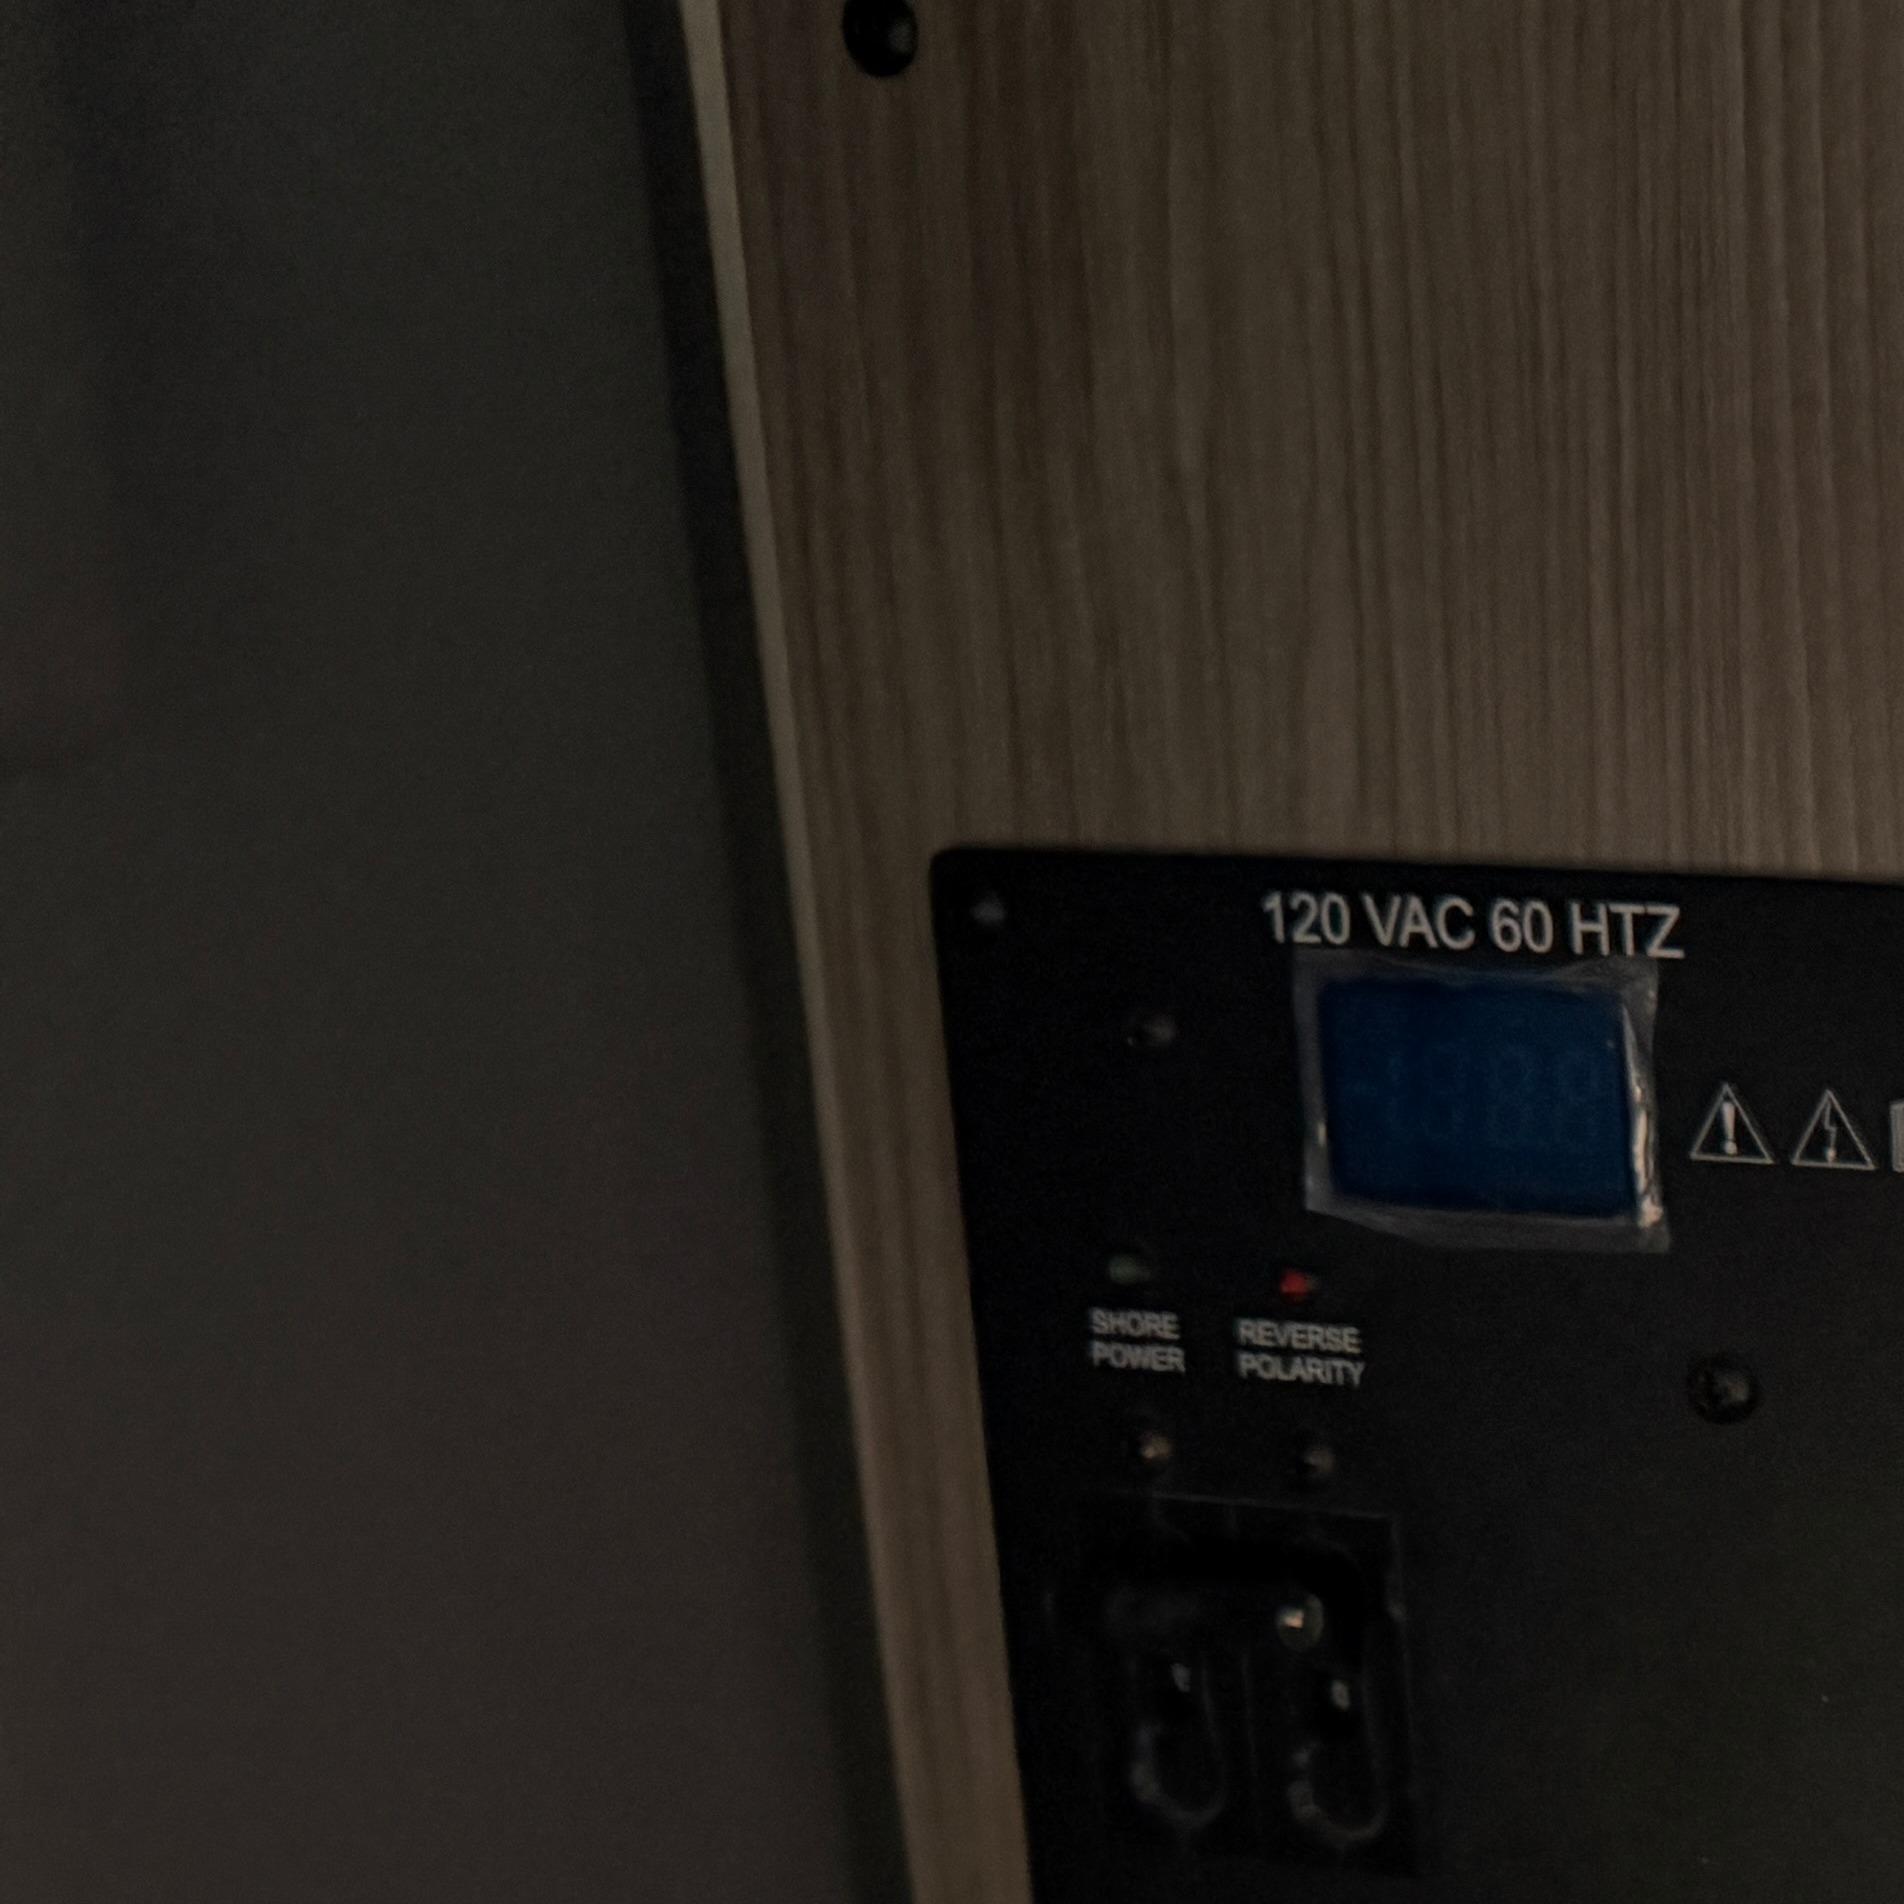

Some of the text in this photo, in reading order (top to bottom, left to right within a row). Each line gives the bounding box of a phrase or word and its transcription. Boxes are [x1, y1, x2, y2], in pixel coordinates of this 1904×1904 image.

[1262, 892, 1686, 959] 120 VAC 60 HTZ
[1091, 1308, 1181, 1340] SHORE
[1237, 1318, 1361, 1355] REVERSE
[1091, 1341, 1186, 1375] POWER
[1238, 1353, 1366, 1389] POLARITY
